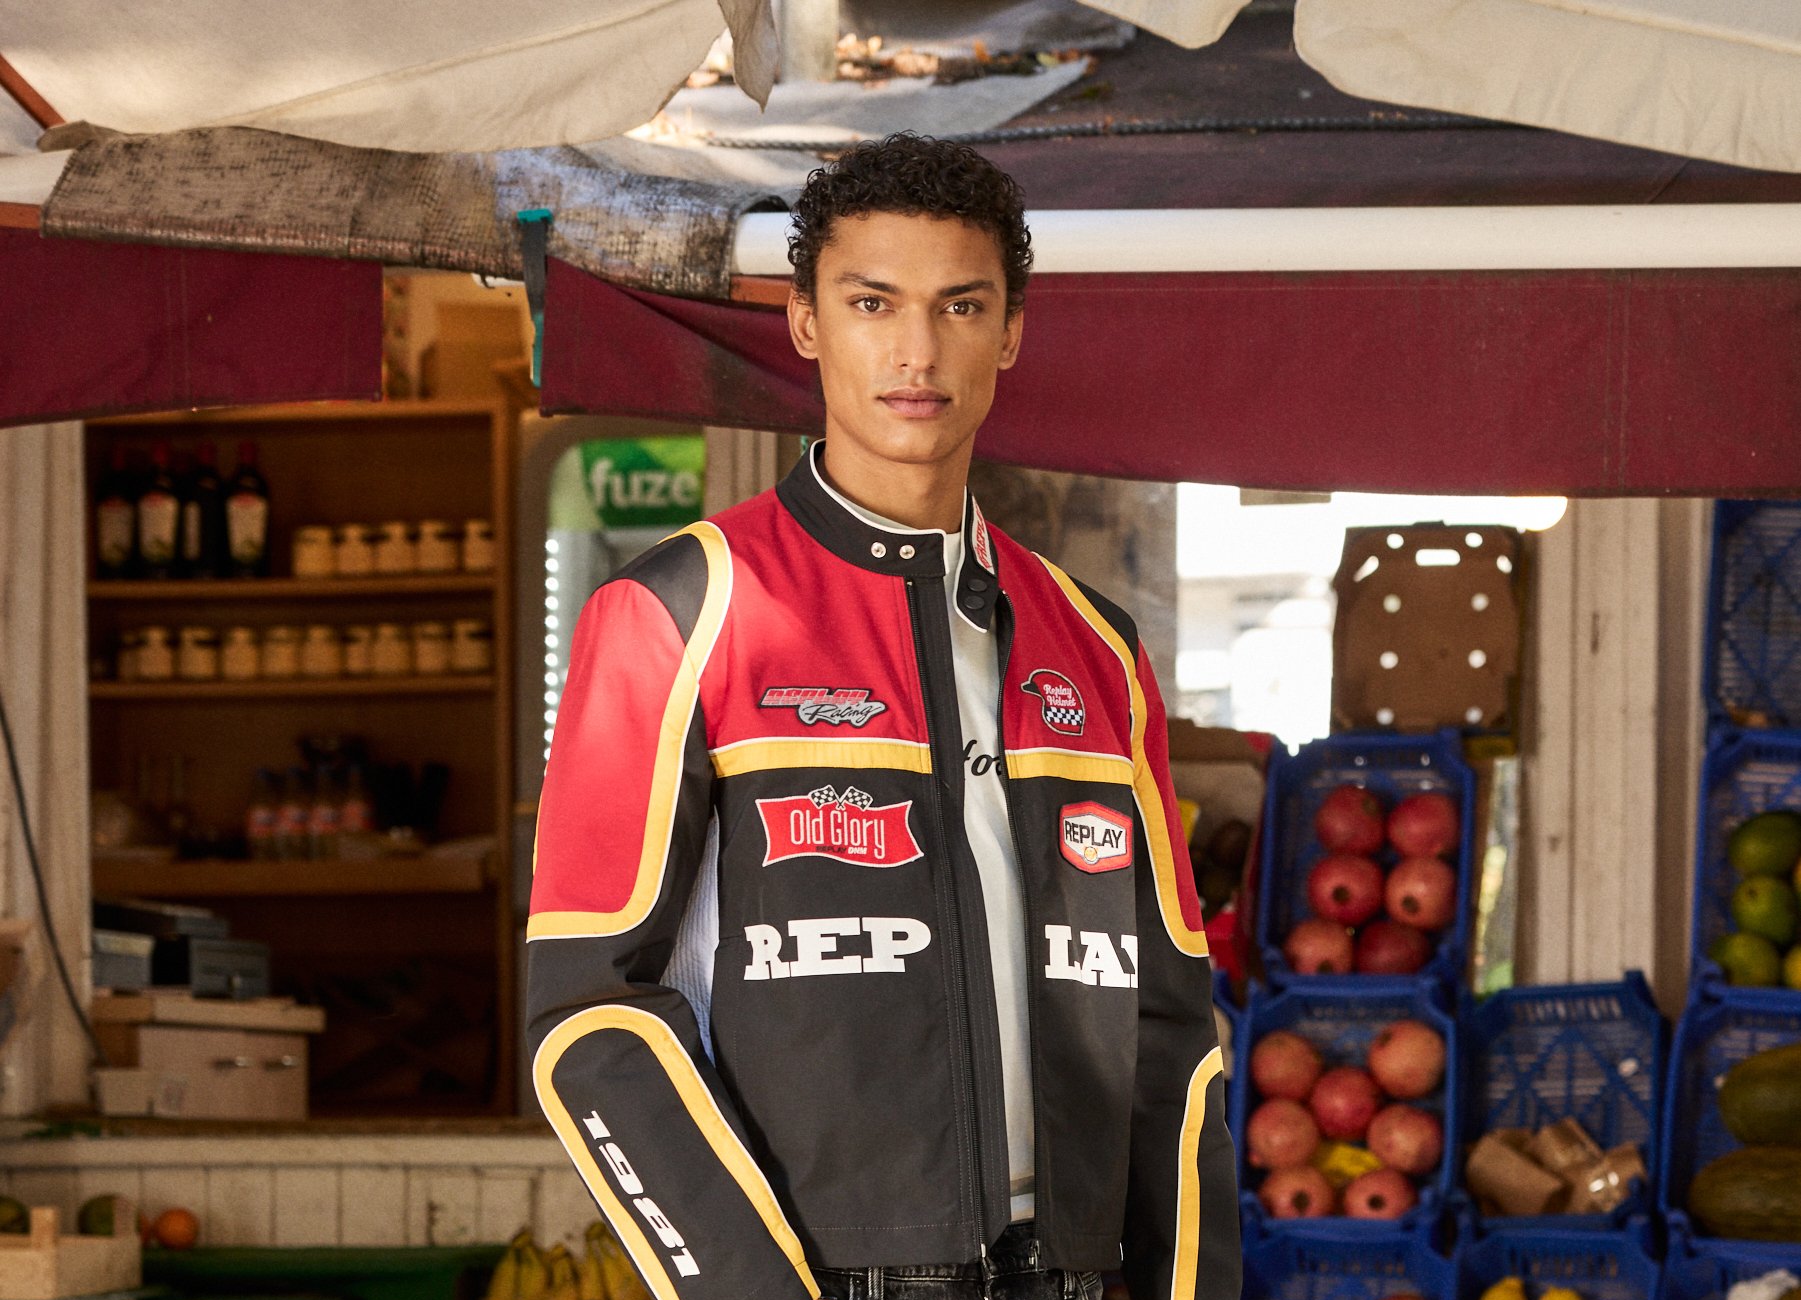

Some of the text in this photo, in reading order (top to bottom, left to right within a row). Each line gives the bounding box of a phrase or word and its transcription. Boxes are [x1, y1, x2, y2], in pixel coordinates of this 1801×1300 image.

[591, 458, 700, 507] fuze
[1043, 684, 1073, 699] Replay
[801, 703, 883, 723] Racing
[790, 809, 886, 859] Old Glory
[848, 846, 868, 855] DNM
[1065, 820, 1123, 849] REPLAY
[743, 916, 932, 981] REP
[583, 1110, 700, 1278] 1981
